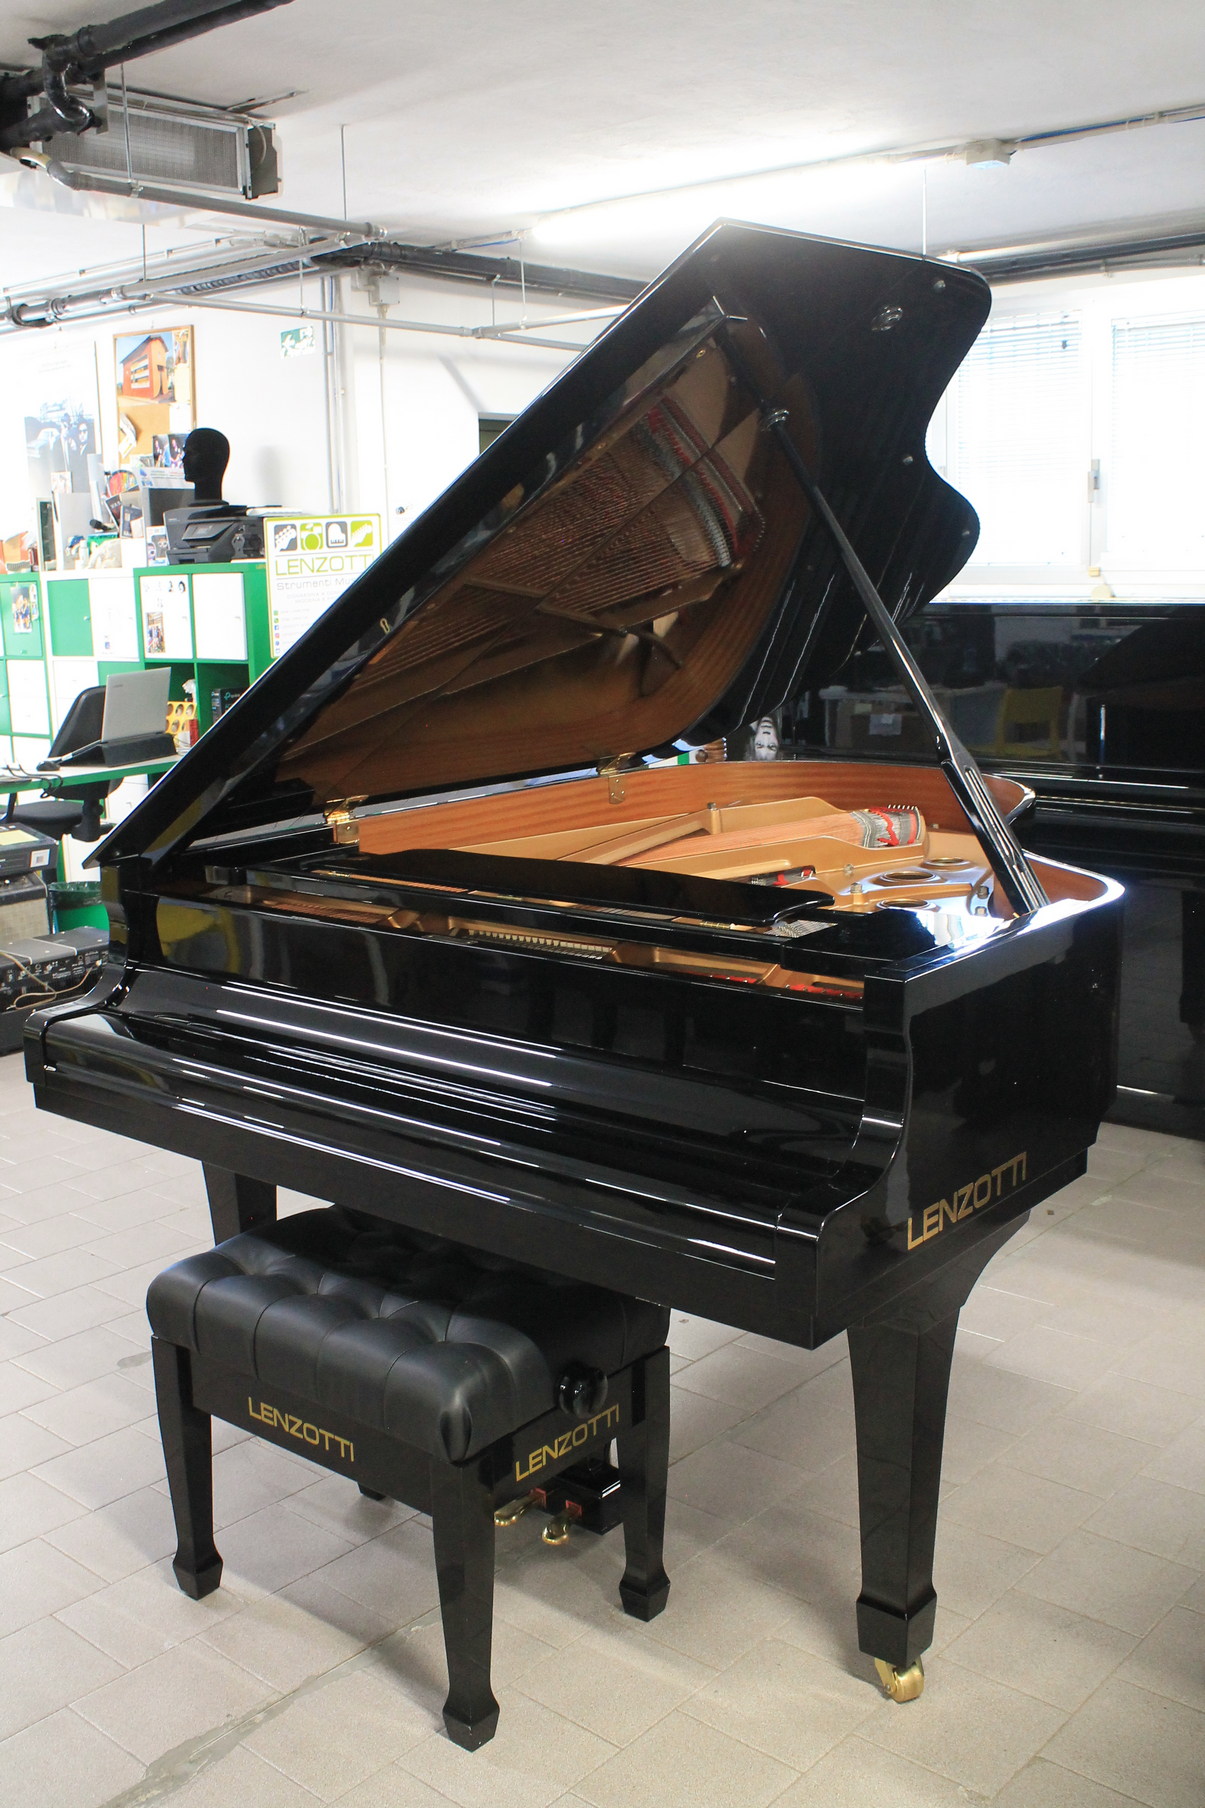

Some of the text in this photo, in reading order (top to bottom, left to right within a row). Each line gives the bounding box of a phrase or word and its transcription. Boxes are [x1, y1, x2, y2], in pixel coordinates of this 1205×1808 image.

[277, 579, 332, 591] Strumenti
[906, 1151, 1027, 1251] LENZOTTI
[248, 1396, 355, 1462] LENZOTTI
[515, 1404, 620, 1482] LENZOTTI
